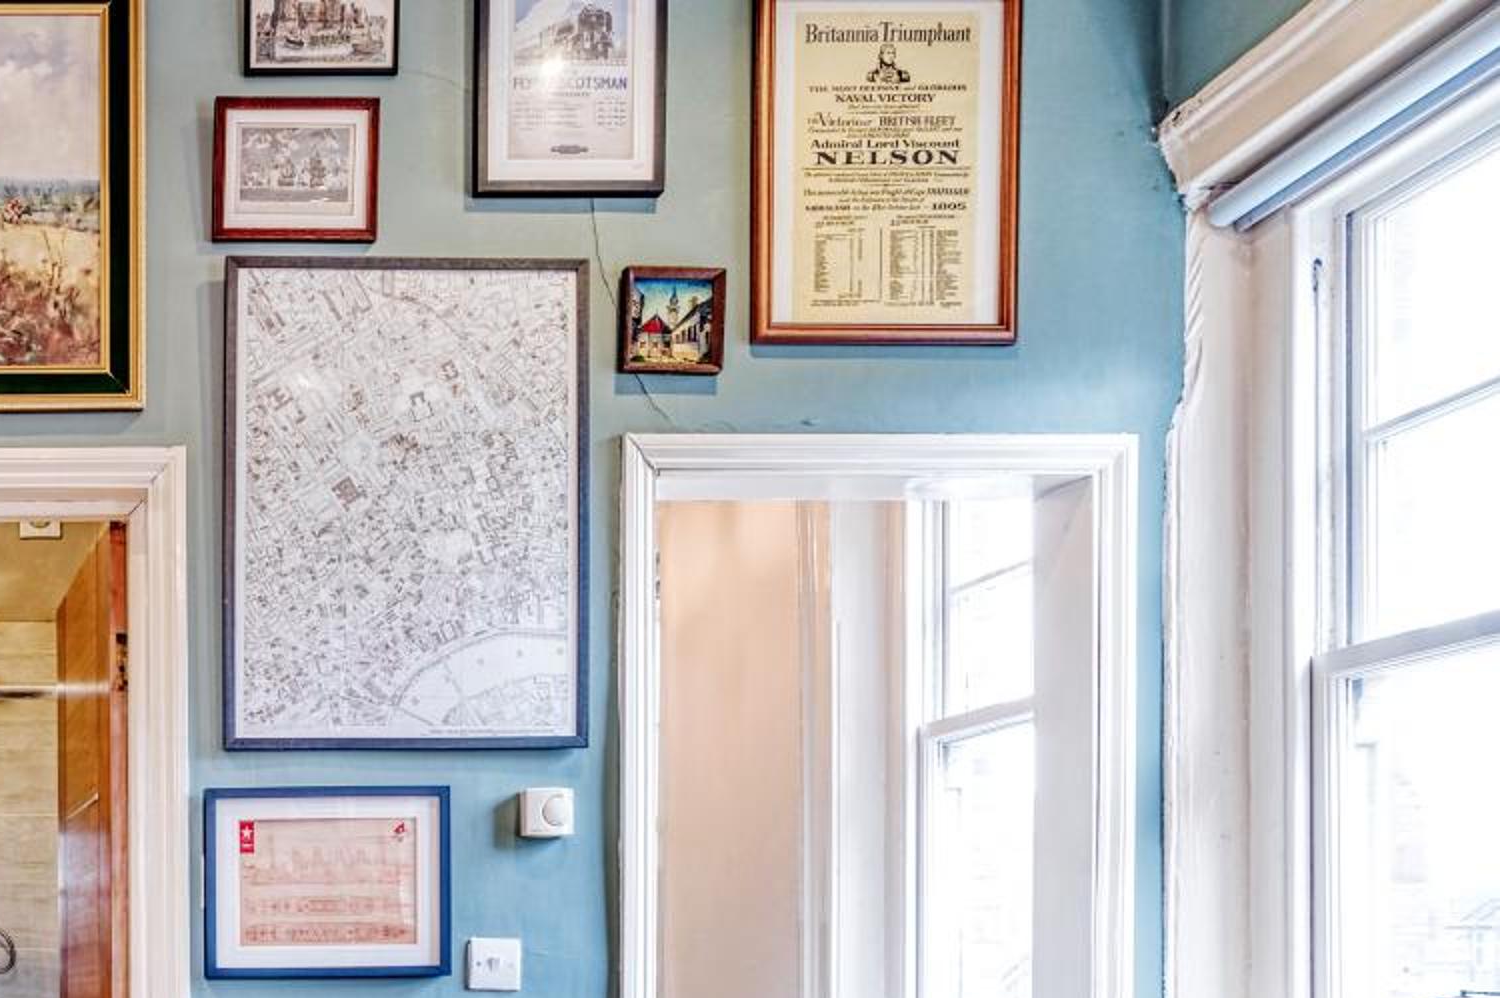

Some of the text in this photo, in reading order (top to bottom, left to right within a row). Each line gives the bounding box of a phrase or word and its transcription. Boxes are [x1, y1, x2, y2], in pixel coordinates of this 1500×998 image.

[805, 21, 971, 47] Britannia Triumphant
[835, 93, 936, 103] NAVAL VICTORY
[810, 139, 960, 150] Admiral Lord Viscount
[815, 150, 961, 165] NELSON
